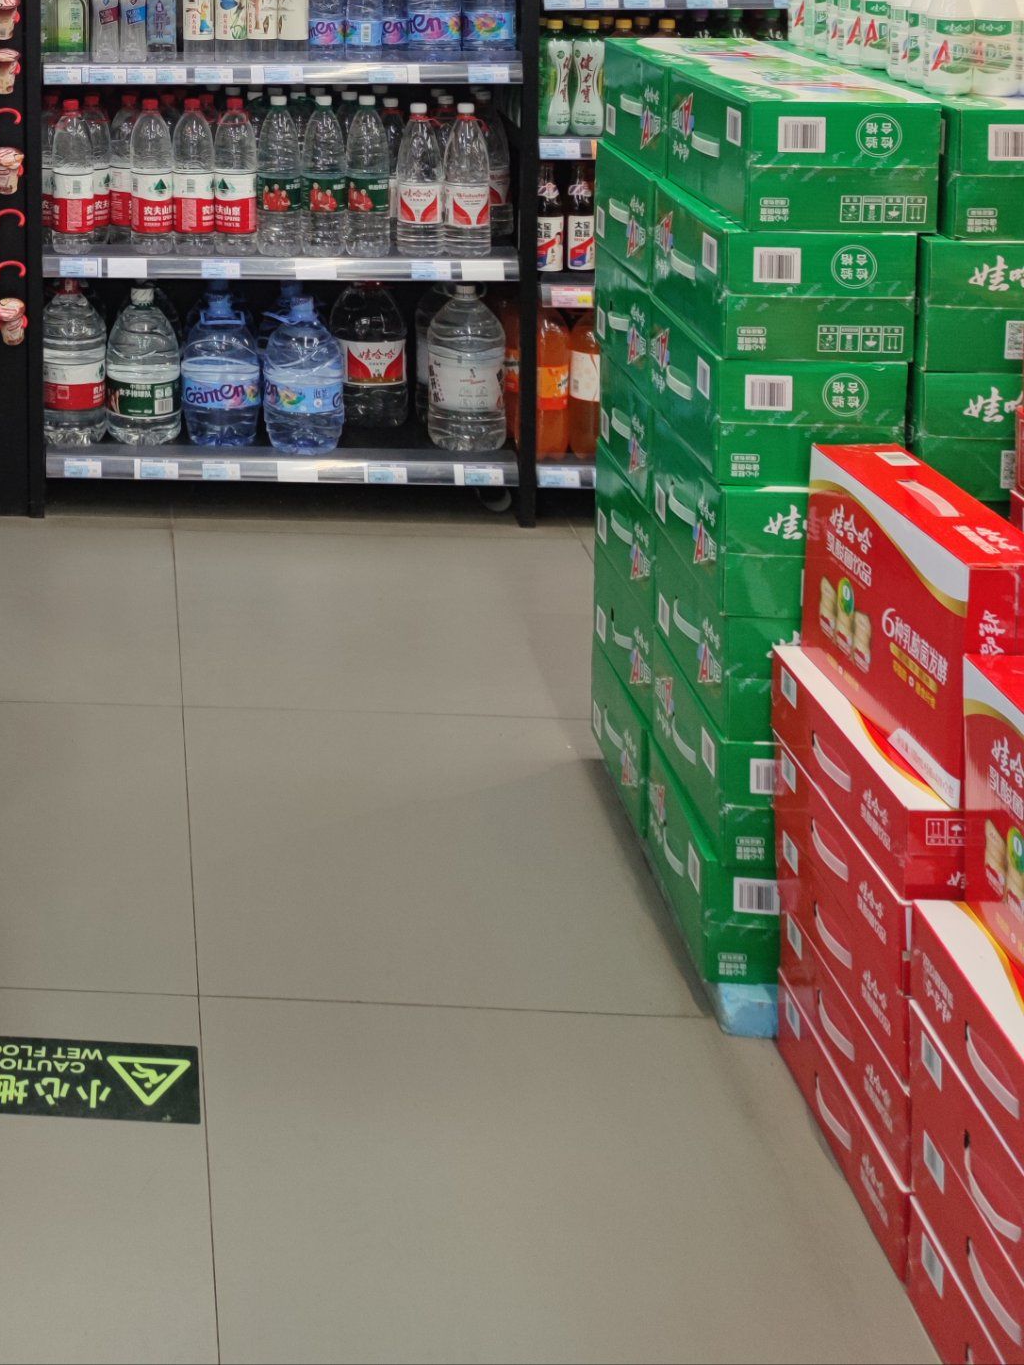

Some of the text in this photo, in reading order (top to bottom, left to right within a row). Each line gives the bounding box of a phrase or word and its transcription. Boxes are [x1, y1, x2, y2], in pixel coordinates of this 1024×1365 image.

[866, 122, 893, 133] 合格
[866, 136, 894, 149] 检验
[840, 254, 868, 265] 合格
[840, 268, 869, 280] 检验
[359, 349, 395, 360] 娃哈哈
[832, 382, 859, 394] 合格
[832, 396, 860, 408] 检验
[829, 504, 873, 555] 娃哈哈
[826, 531, 872, 587] 乳酸菌饮品
[881, 607, 948, 685] 6种乳酸菌发酵
[53, 1046, 103, 1061] WET
